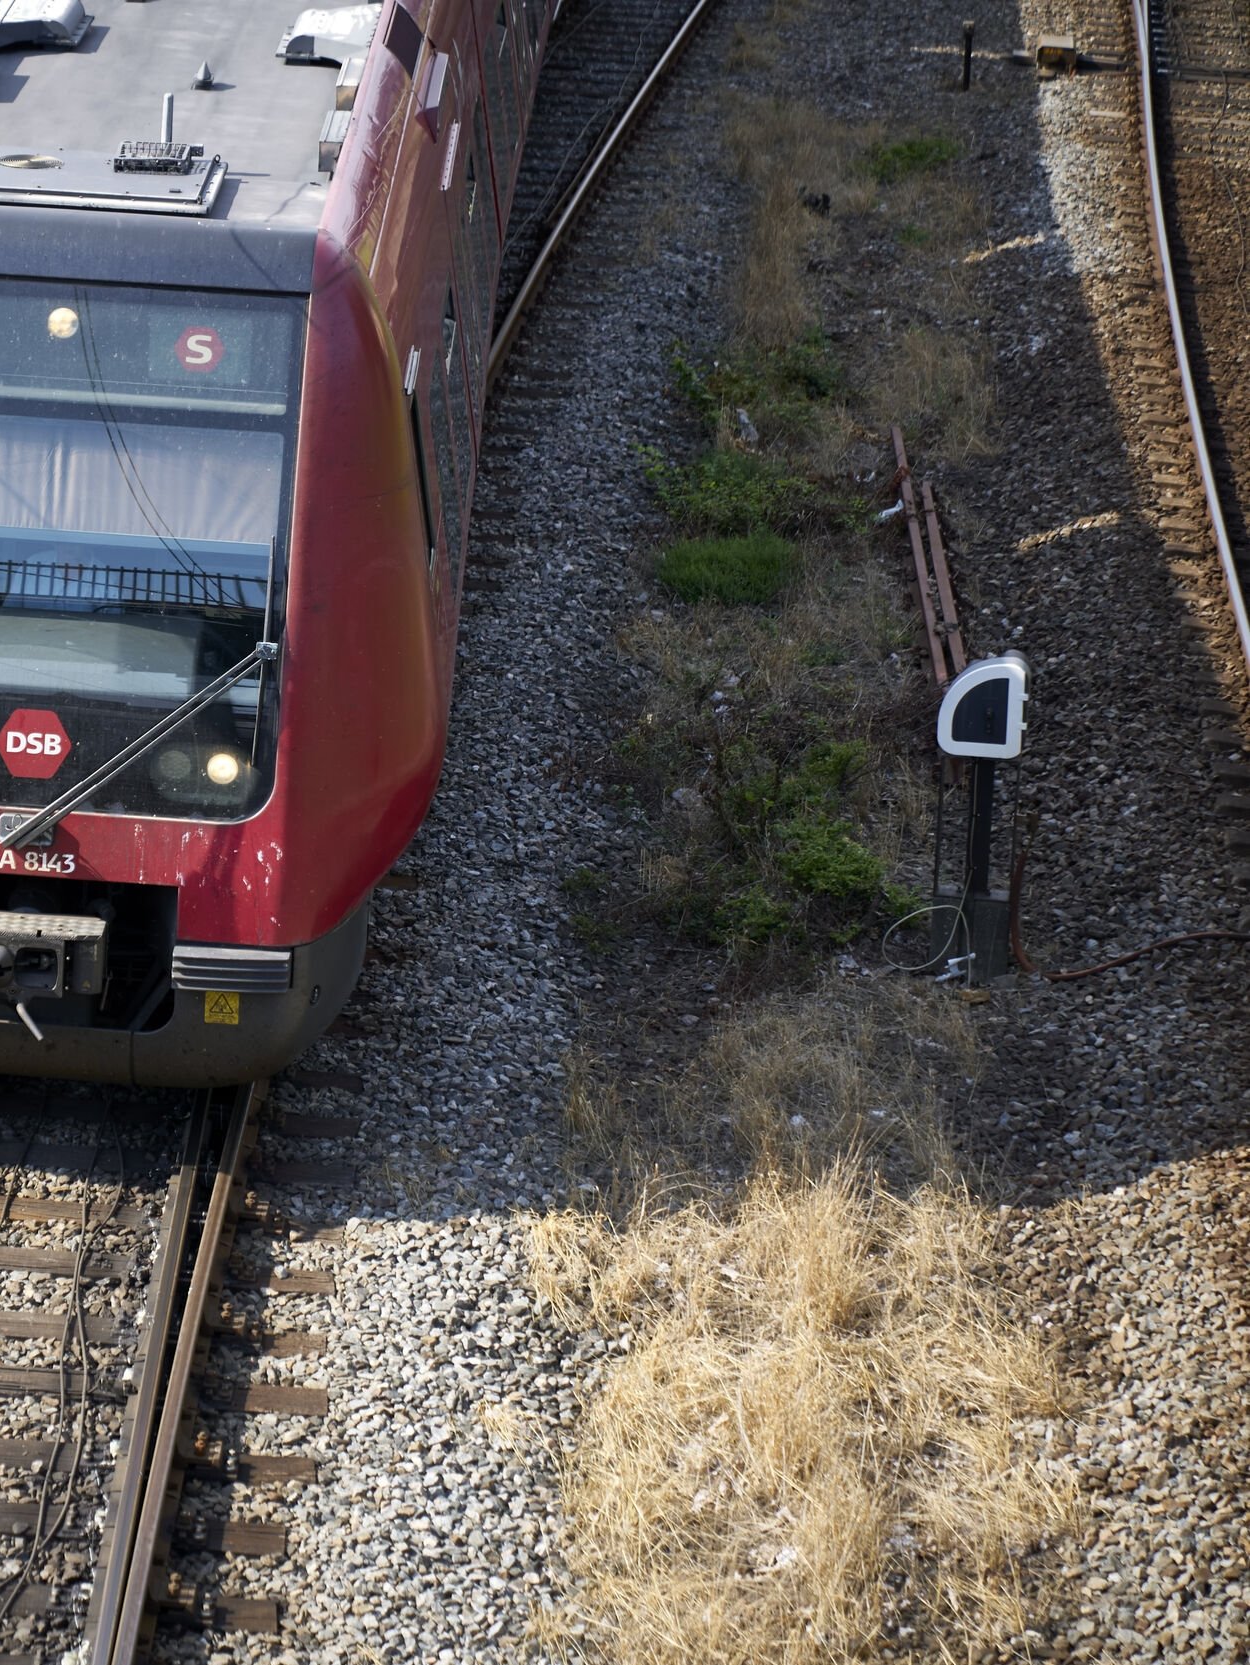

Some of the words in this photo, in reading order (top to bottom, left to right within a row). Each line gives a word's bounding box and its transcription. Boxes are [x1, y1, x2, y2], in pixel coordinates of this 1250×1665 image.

[185, 334, 213, 365] S
[6, 731, 62, 756] DSB
[24, 851, 76, 874] 8143
